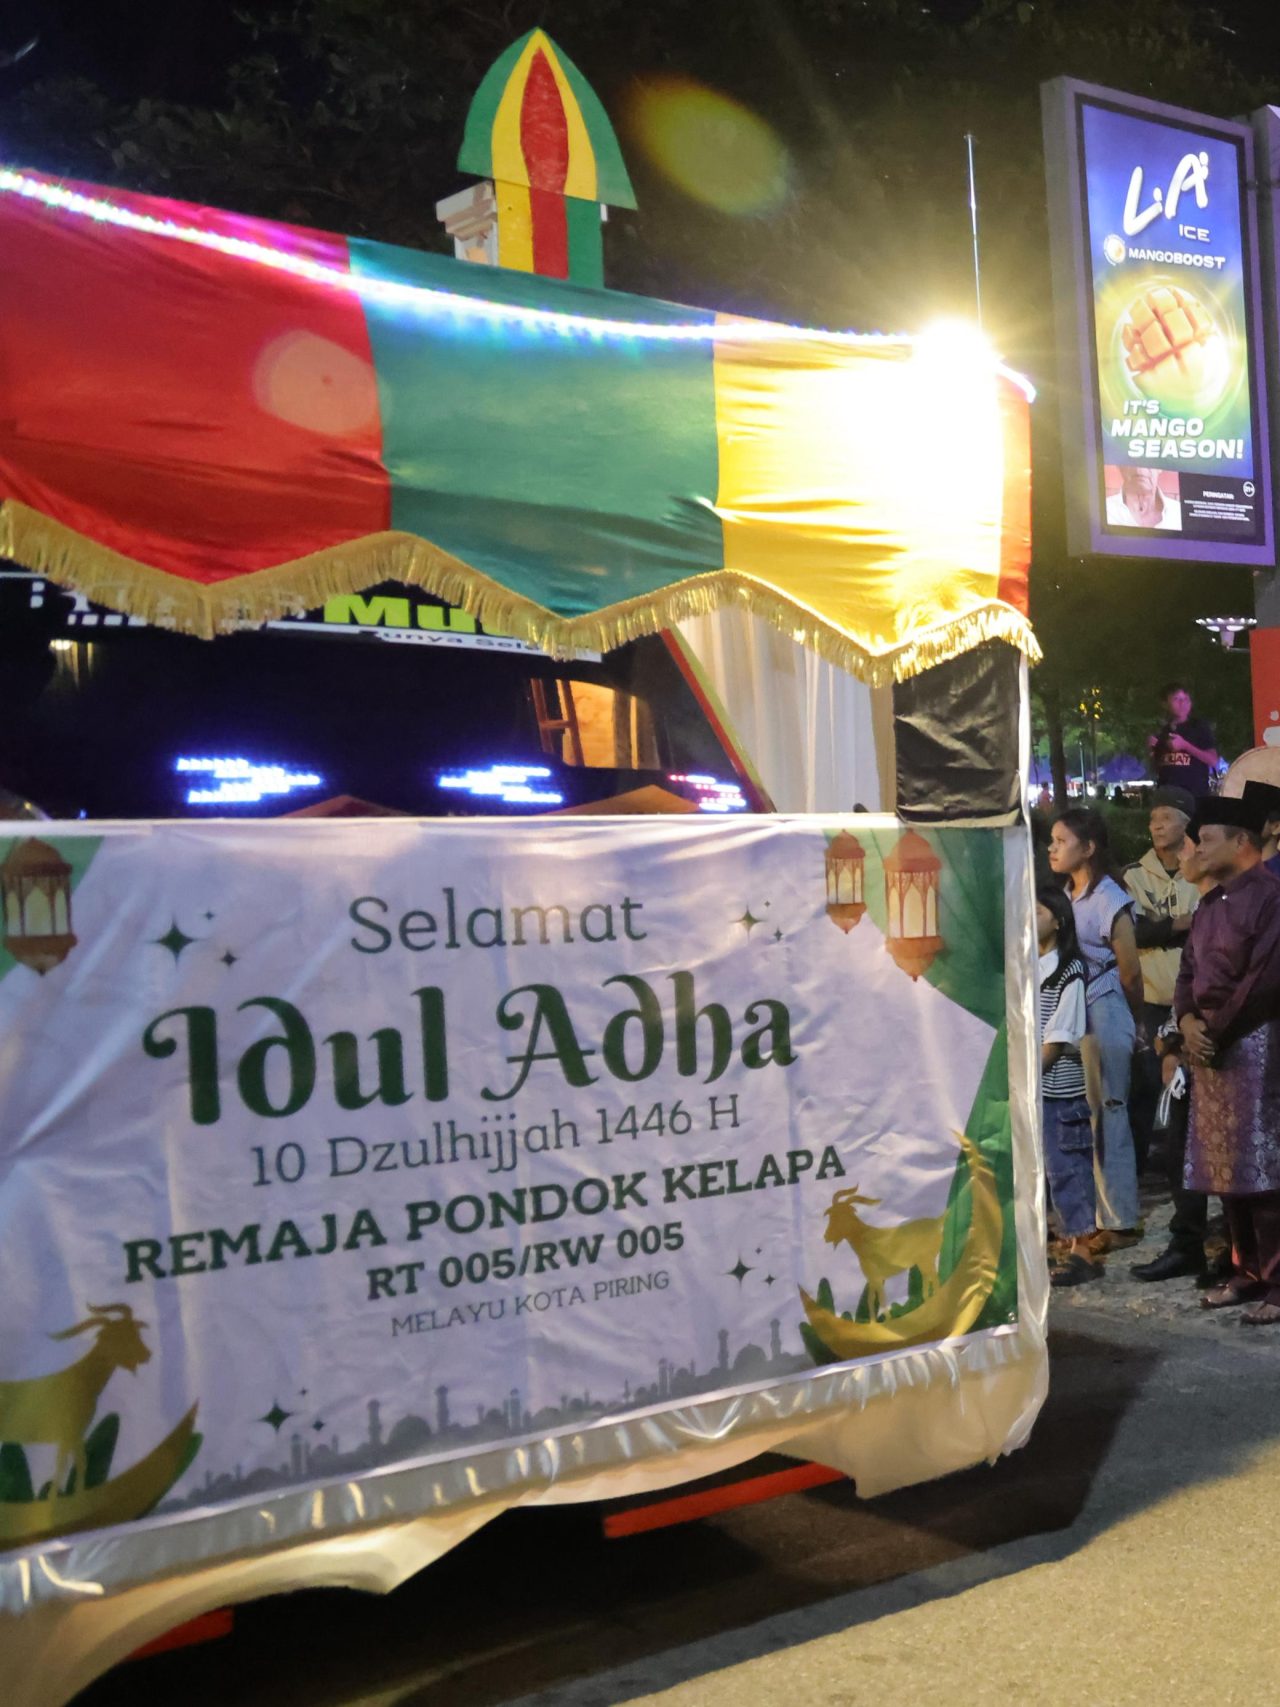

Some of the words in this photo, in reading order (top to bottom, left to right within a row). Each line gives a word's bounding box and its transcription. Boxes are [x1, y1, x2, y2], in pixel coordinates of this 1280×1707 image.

[1128, 247, 1226, 270] MANGOBOOST
[1179, 224, 1210, 242] ICE
[1111, 418, 1204, 438] MANGO
[1123, 399, 1160, 415] IT'S
[1127, 439, 1244, 459] SEASON!
[349, 888, 648, 954] Selamat
[142, 985, 451, 1126] Idul
[481, 970, 798, 1100] Adha
[251, 1142, 307, 1187] 10
[328, 1110, 581, 1174] Dzulhijjah
[597, 1099, 693, 1145] 1446
[708, 1093, 741, 1129] H
[123, 1212, 387, 1285] REMAJA
[405, 1171, 649, 1242] PONDOK
[662, 1144, 847, 1204] KELAPA
[366, 1260, 427, 1301] RT
[438, 1234, 606, 1290] 005/RW
[616, 1221, 685, 1258] 005
[391, 1298, 507, 1338] MELAYU
[515, 1285, 587, 1315] KOTA
[593, 1269, 671, 1301] PIRING
